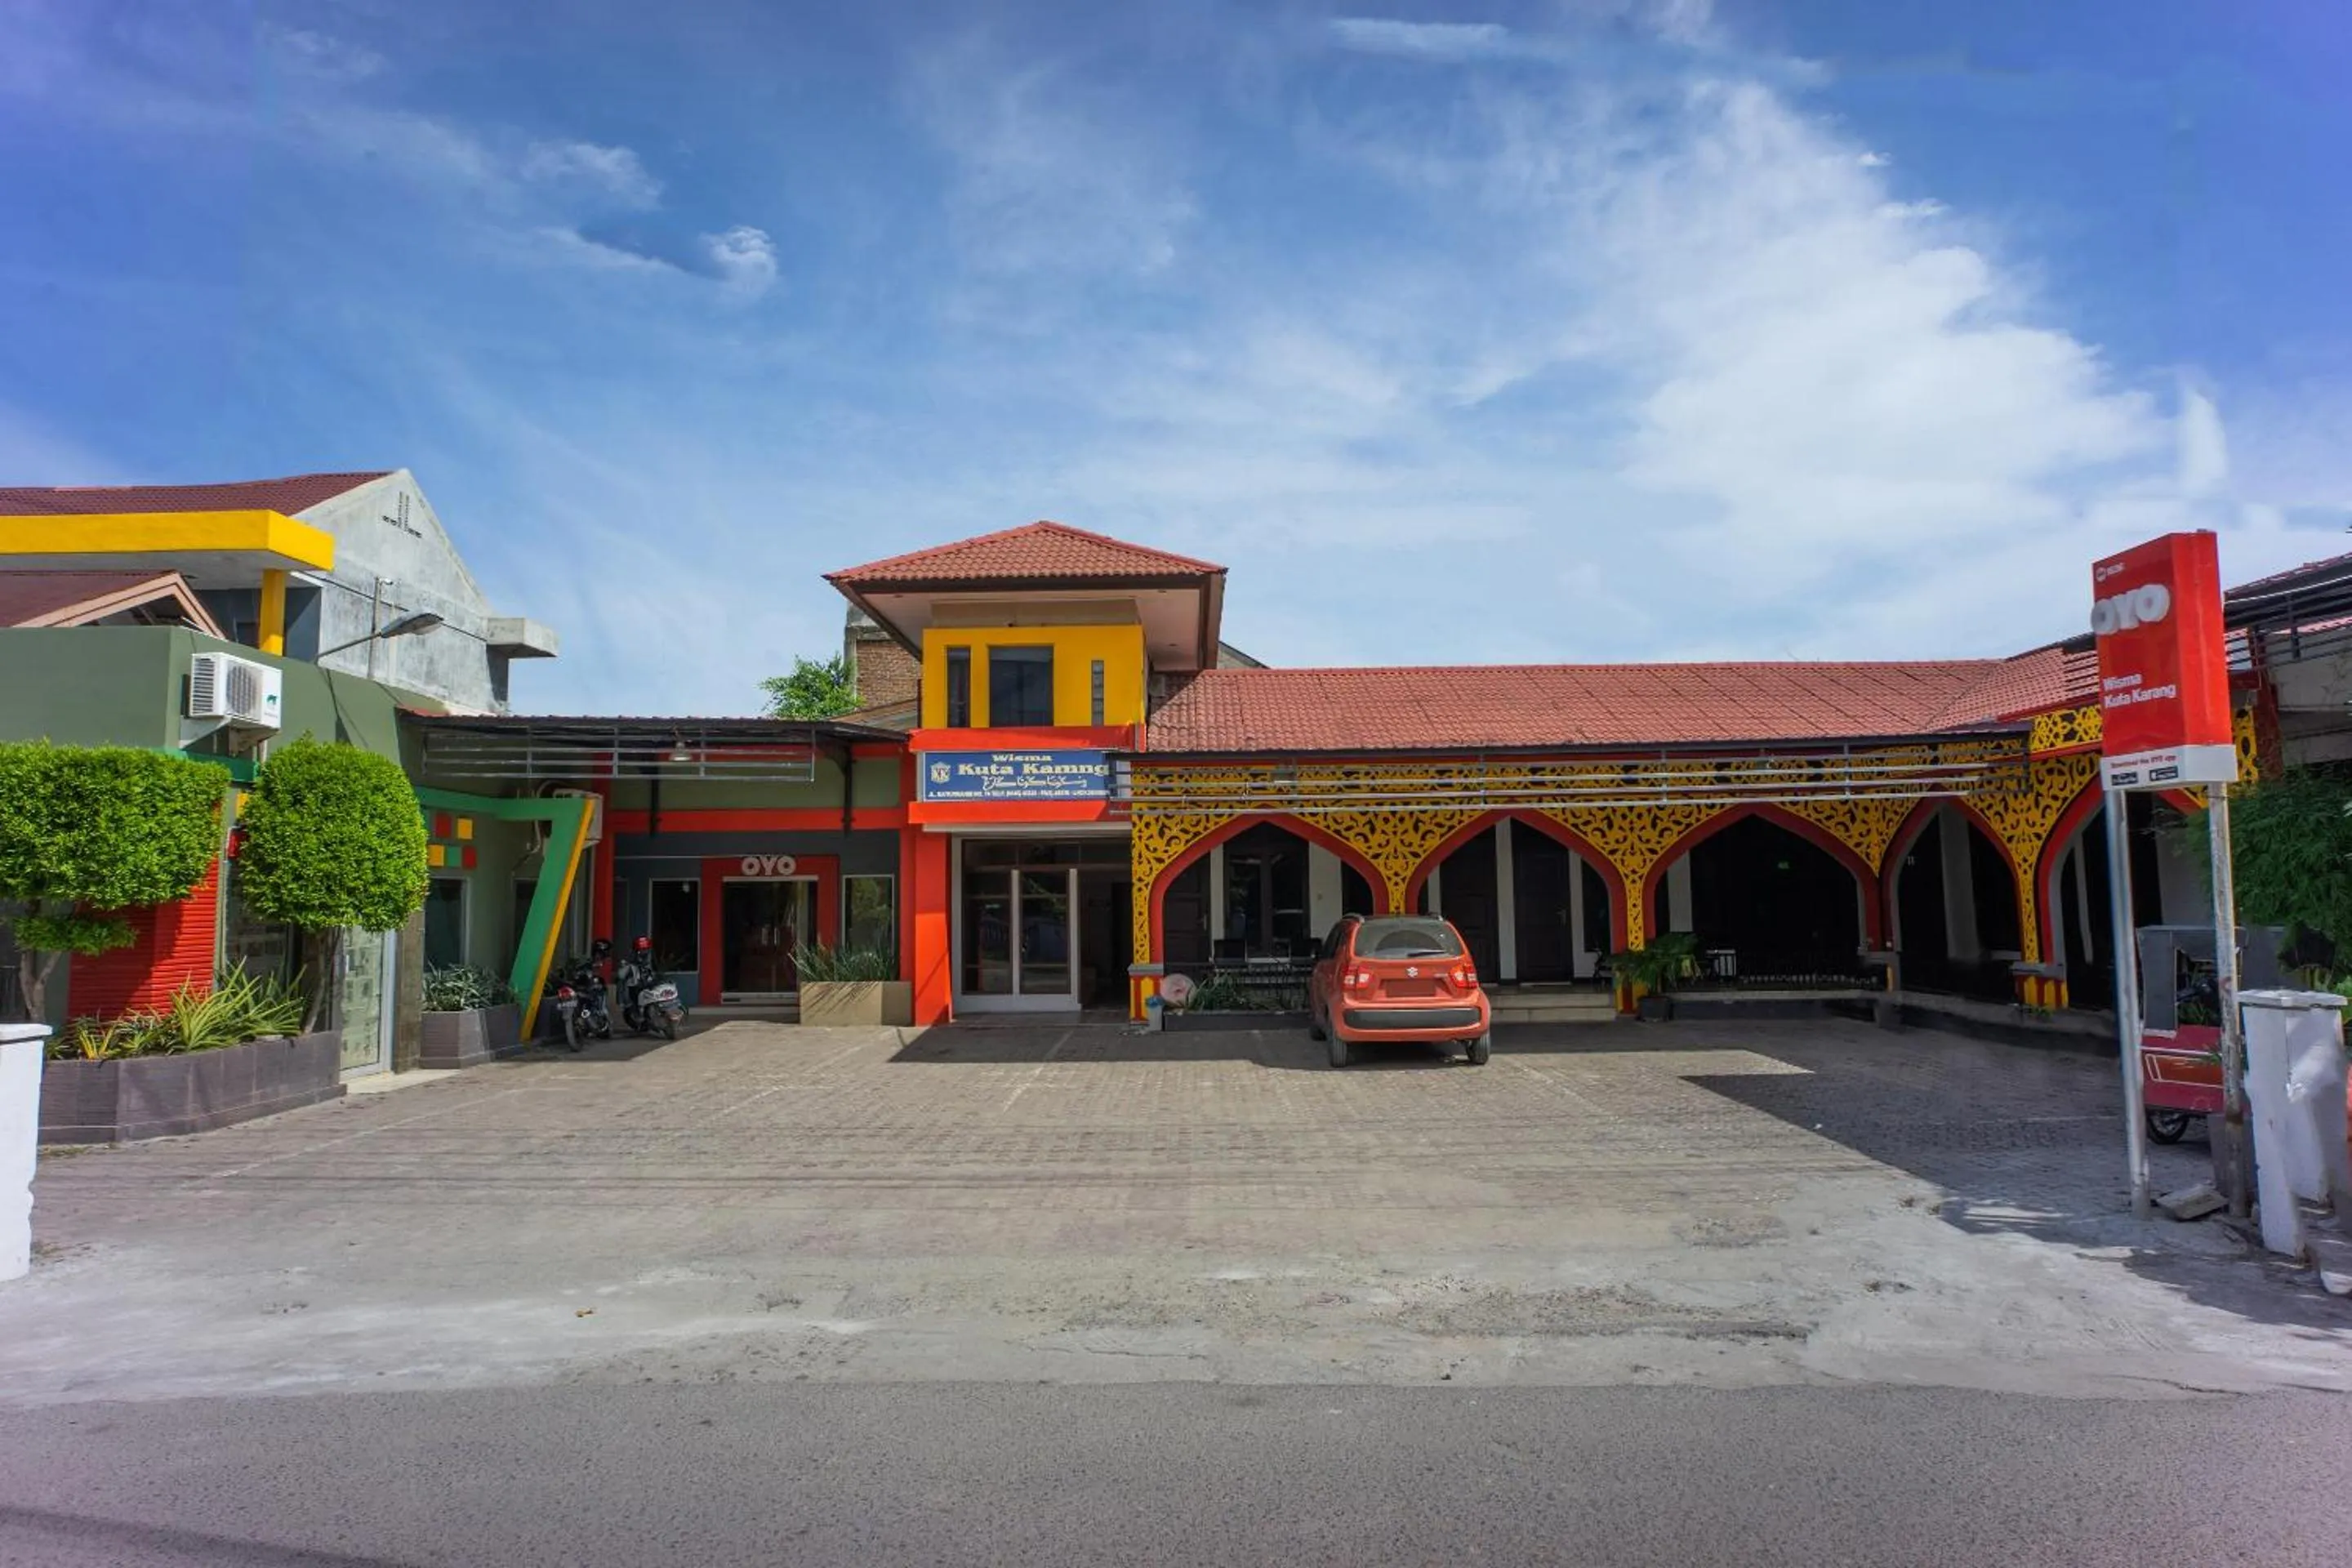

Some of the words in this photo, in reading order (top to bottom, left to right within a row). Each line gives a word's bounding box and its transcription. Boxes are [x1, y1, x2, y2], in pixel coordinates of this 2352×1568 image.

[2091, 584, 2171, 635] OYO
[2104, 693, 2131, 708] Kuta
[991, 754, 1052, 762] Wisma
[957, 763, 1013, 775] Kuta
[741, 855, 797, 876] OYO
